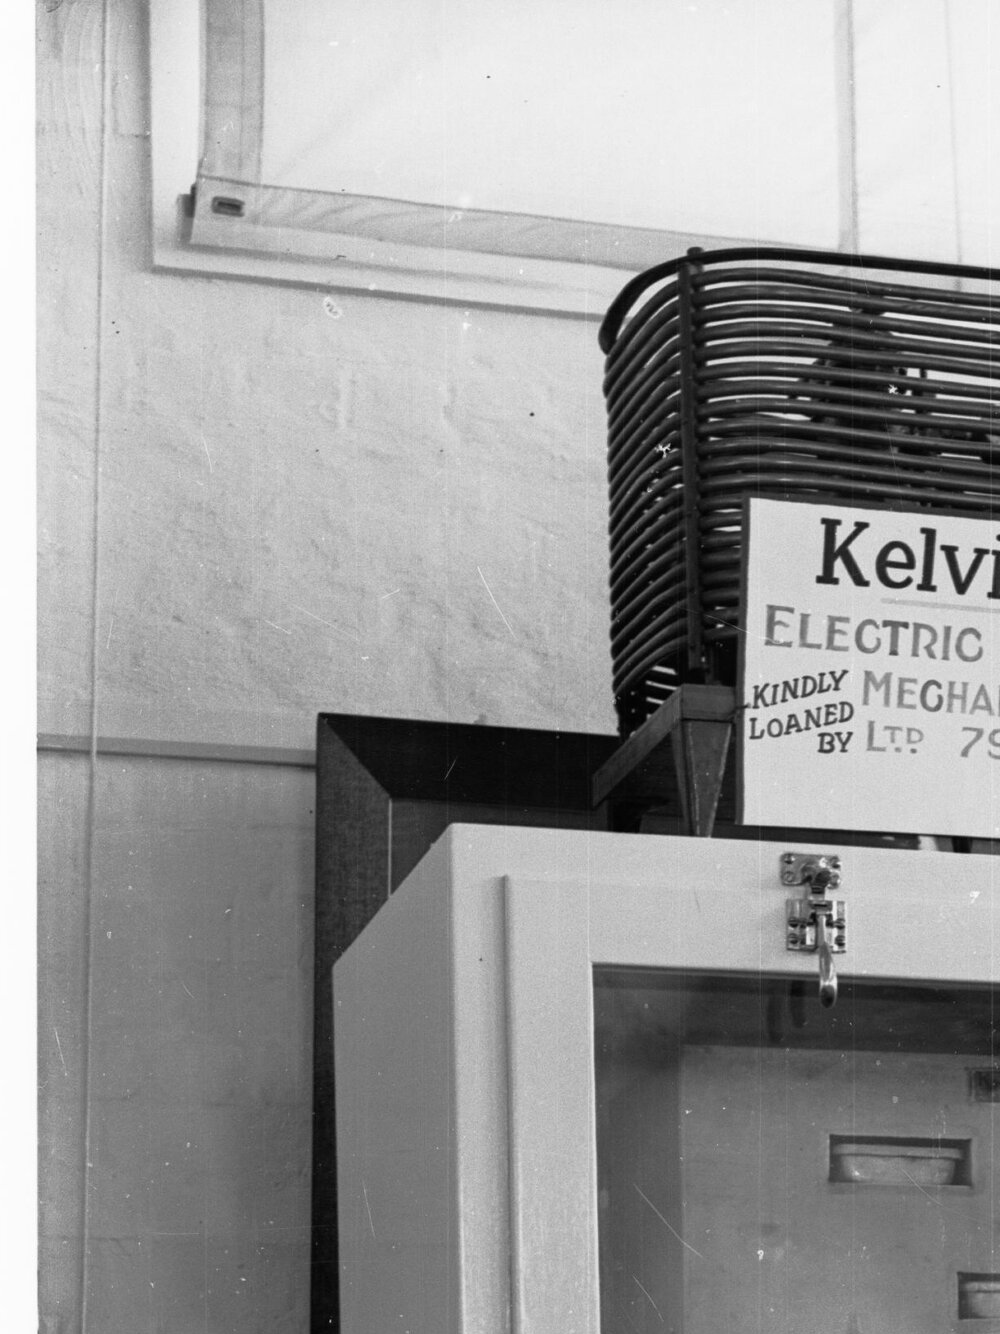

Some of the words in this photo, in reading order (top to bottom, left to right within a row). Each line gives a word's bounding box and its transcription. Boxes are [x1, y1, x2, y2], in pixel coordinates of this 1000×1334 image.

[764, 604, 984, 663] ELECTRIC
[751, 670, 849, 709] KINDLY
[748, 702, 854, 740] LOANED
[817, 732, 853, 755] BY
